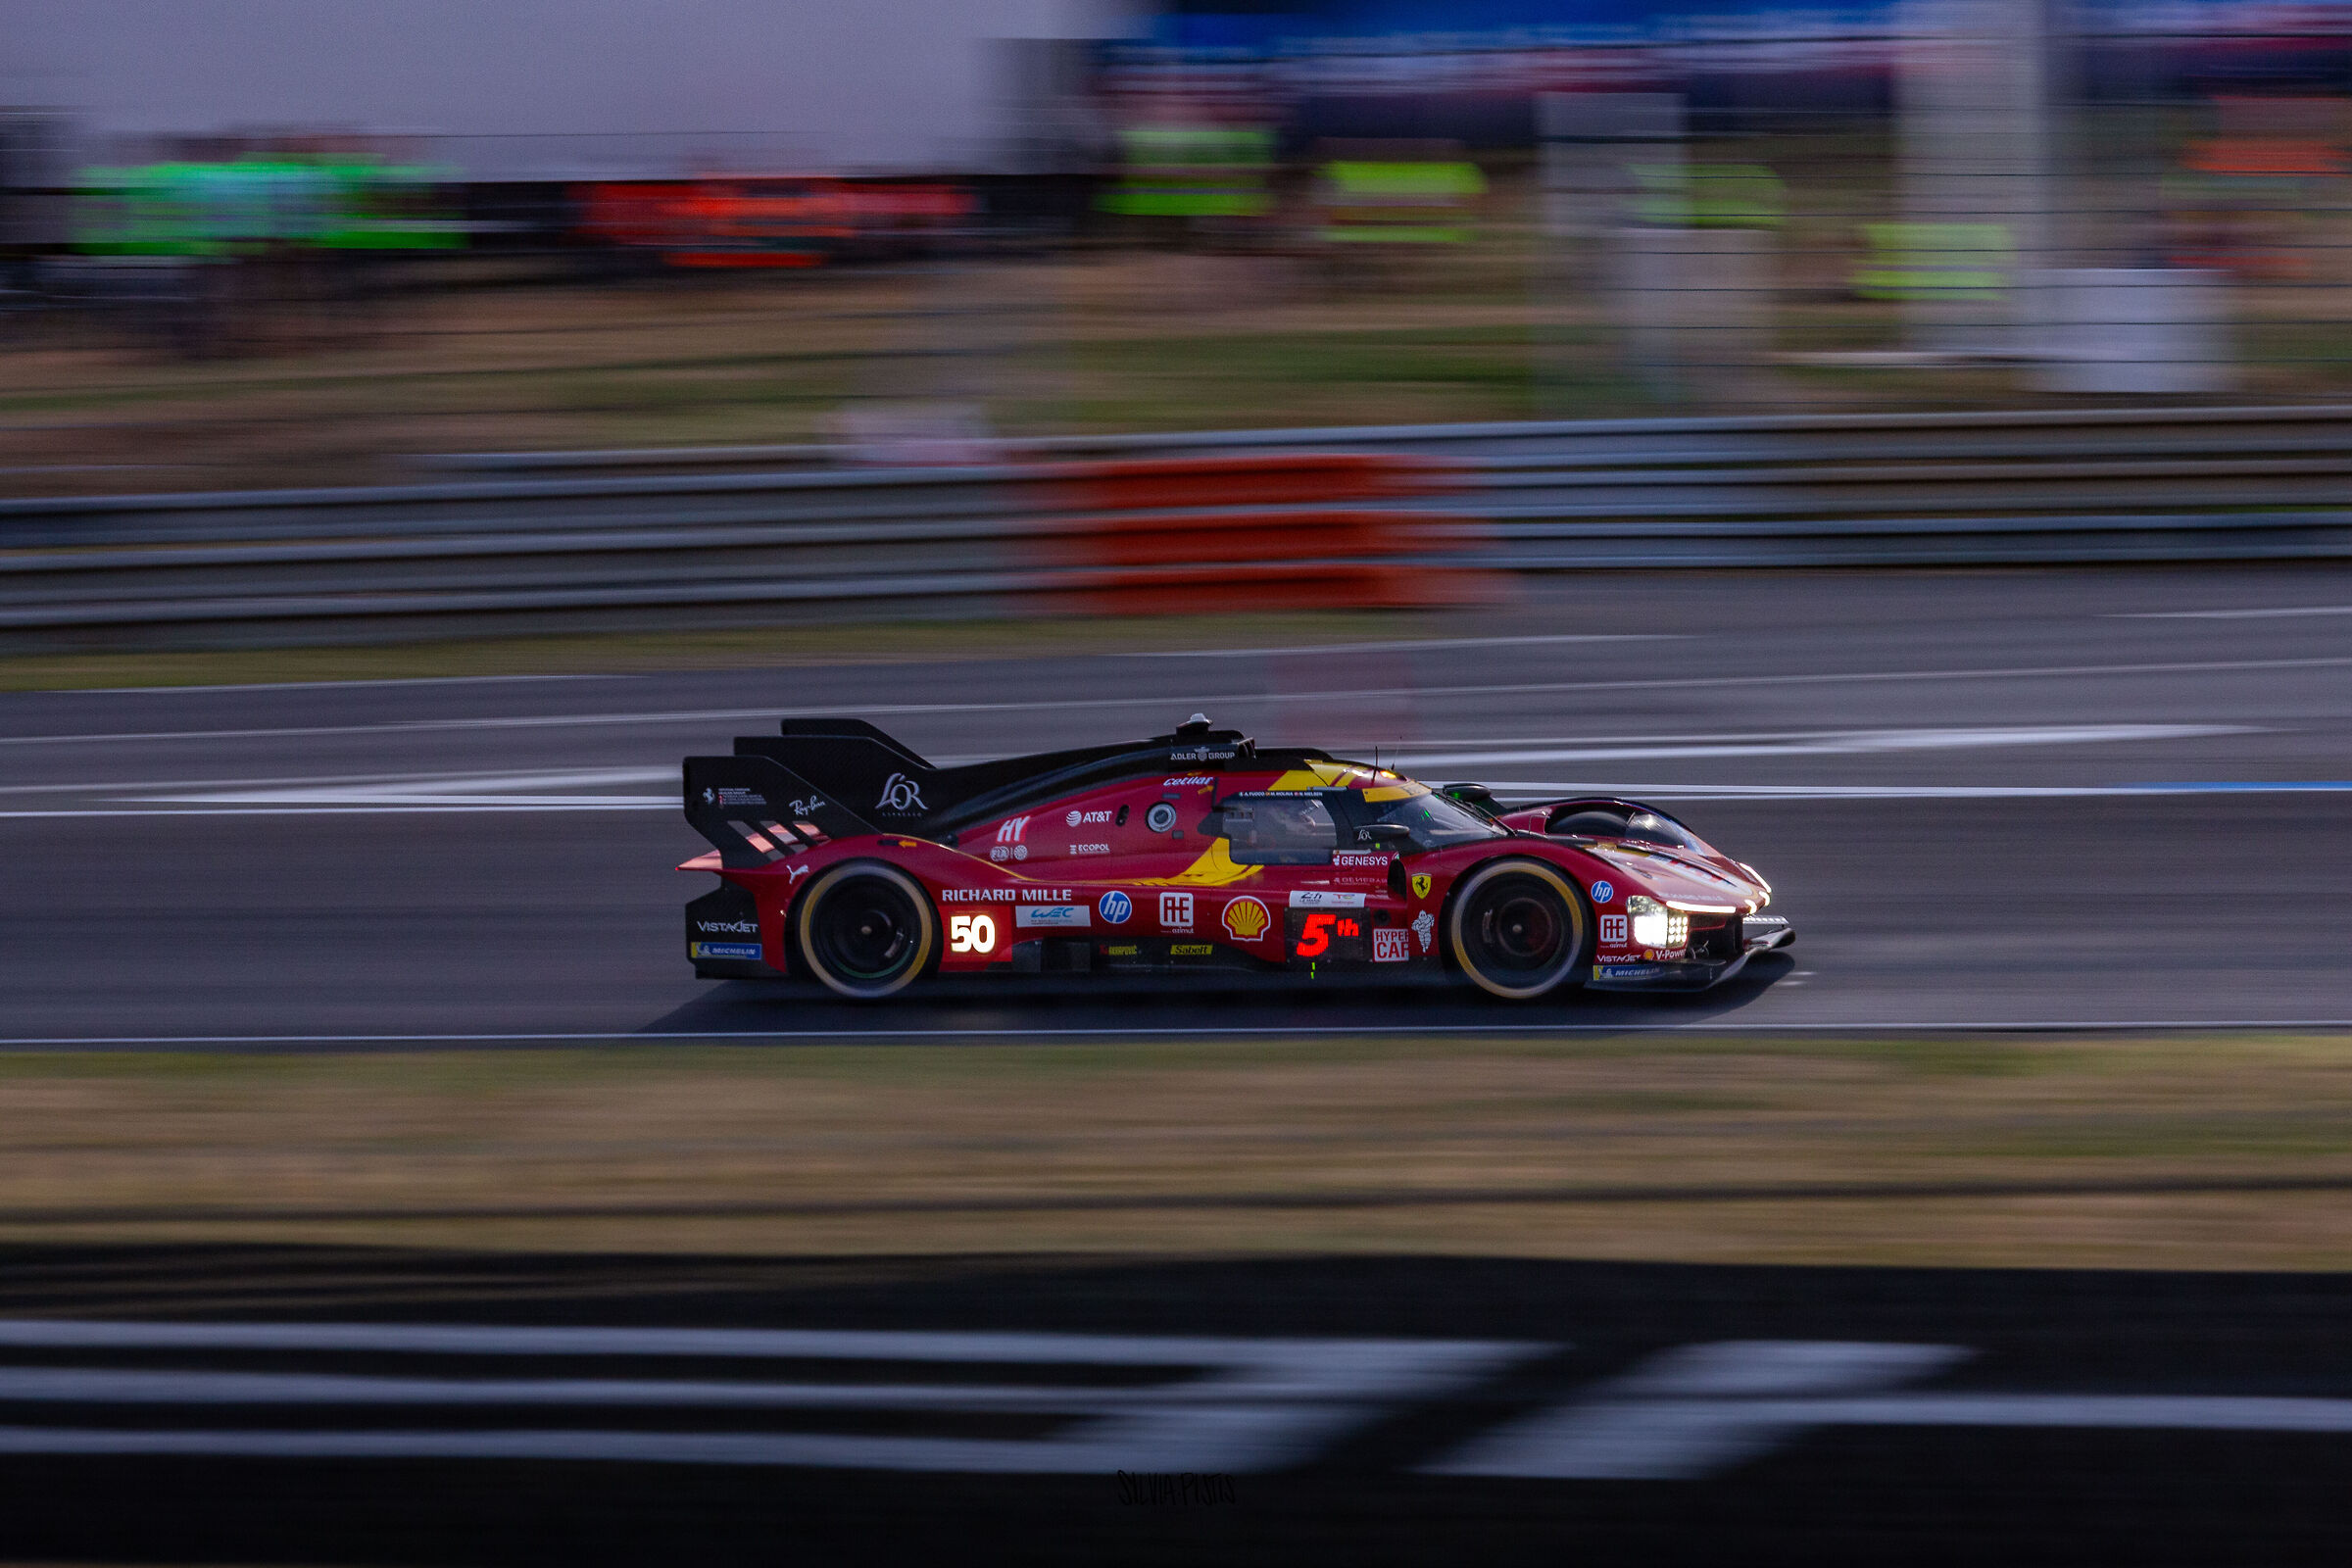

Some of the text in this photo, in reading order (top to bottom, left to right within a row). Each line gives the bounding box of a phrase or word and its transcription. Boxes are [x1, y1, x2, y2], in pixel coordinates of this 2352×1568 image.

[1170, 751, 1235, 760] ADLER GROUP
[1083, 810, 1112, 823] AT&T
[997, 816, 1030, 842] HY
[1341, 856, 1388, 866] GENESYS
[942, 889, 1072, 902] RICHARD MILLE
[1594, 882, 1610, 902] hp
[1103, 891, 1128, 922] hp
[951, 914, 996, 954] 50
[711, 947, 757, 956] MICHELIN
